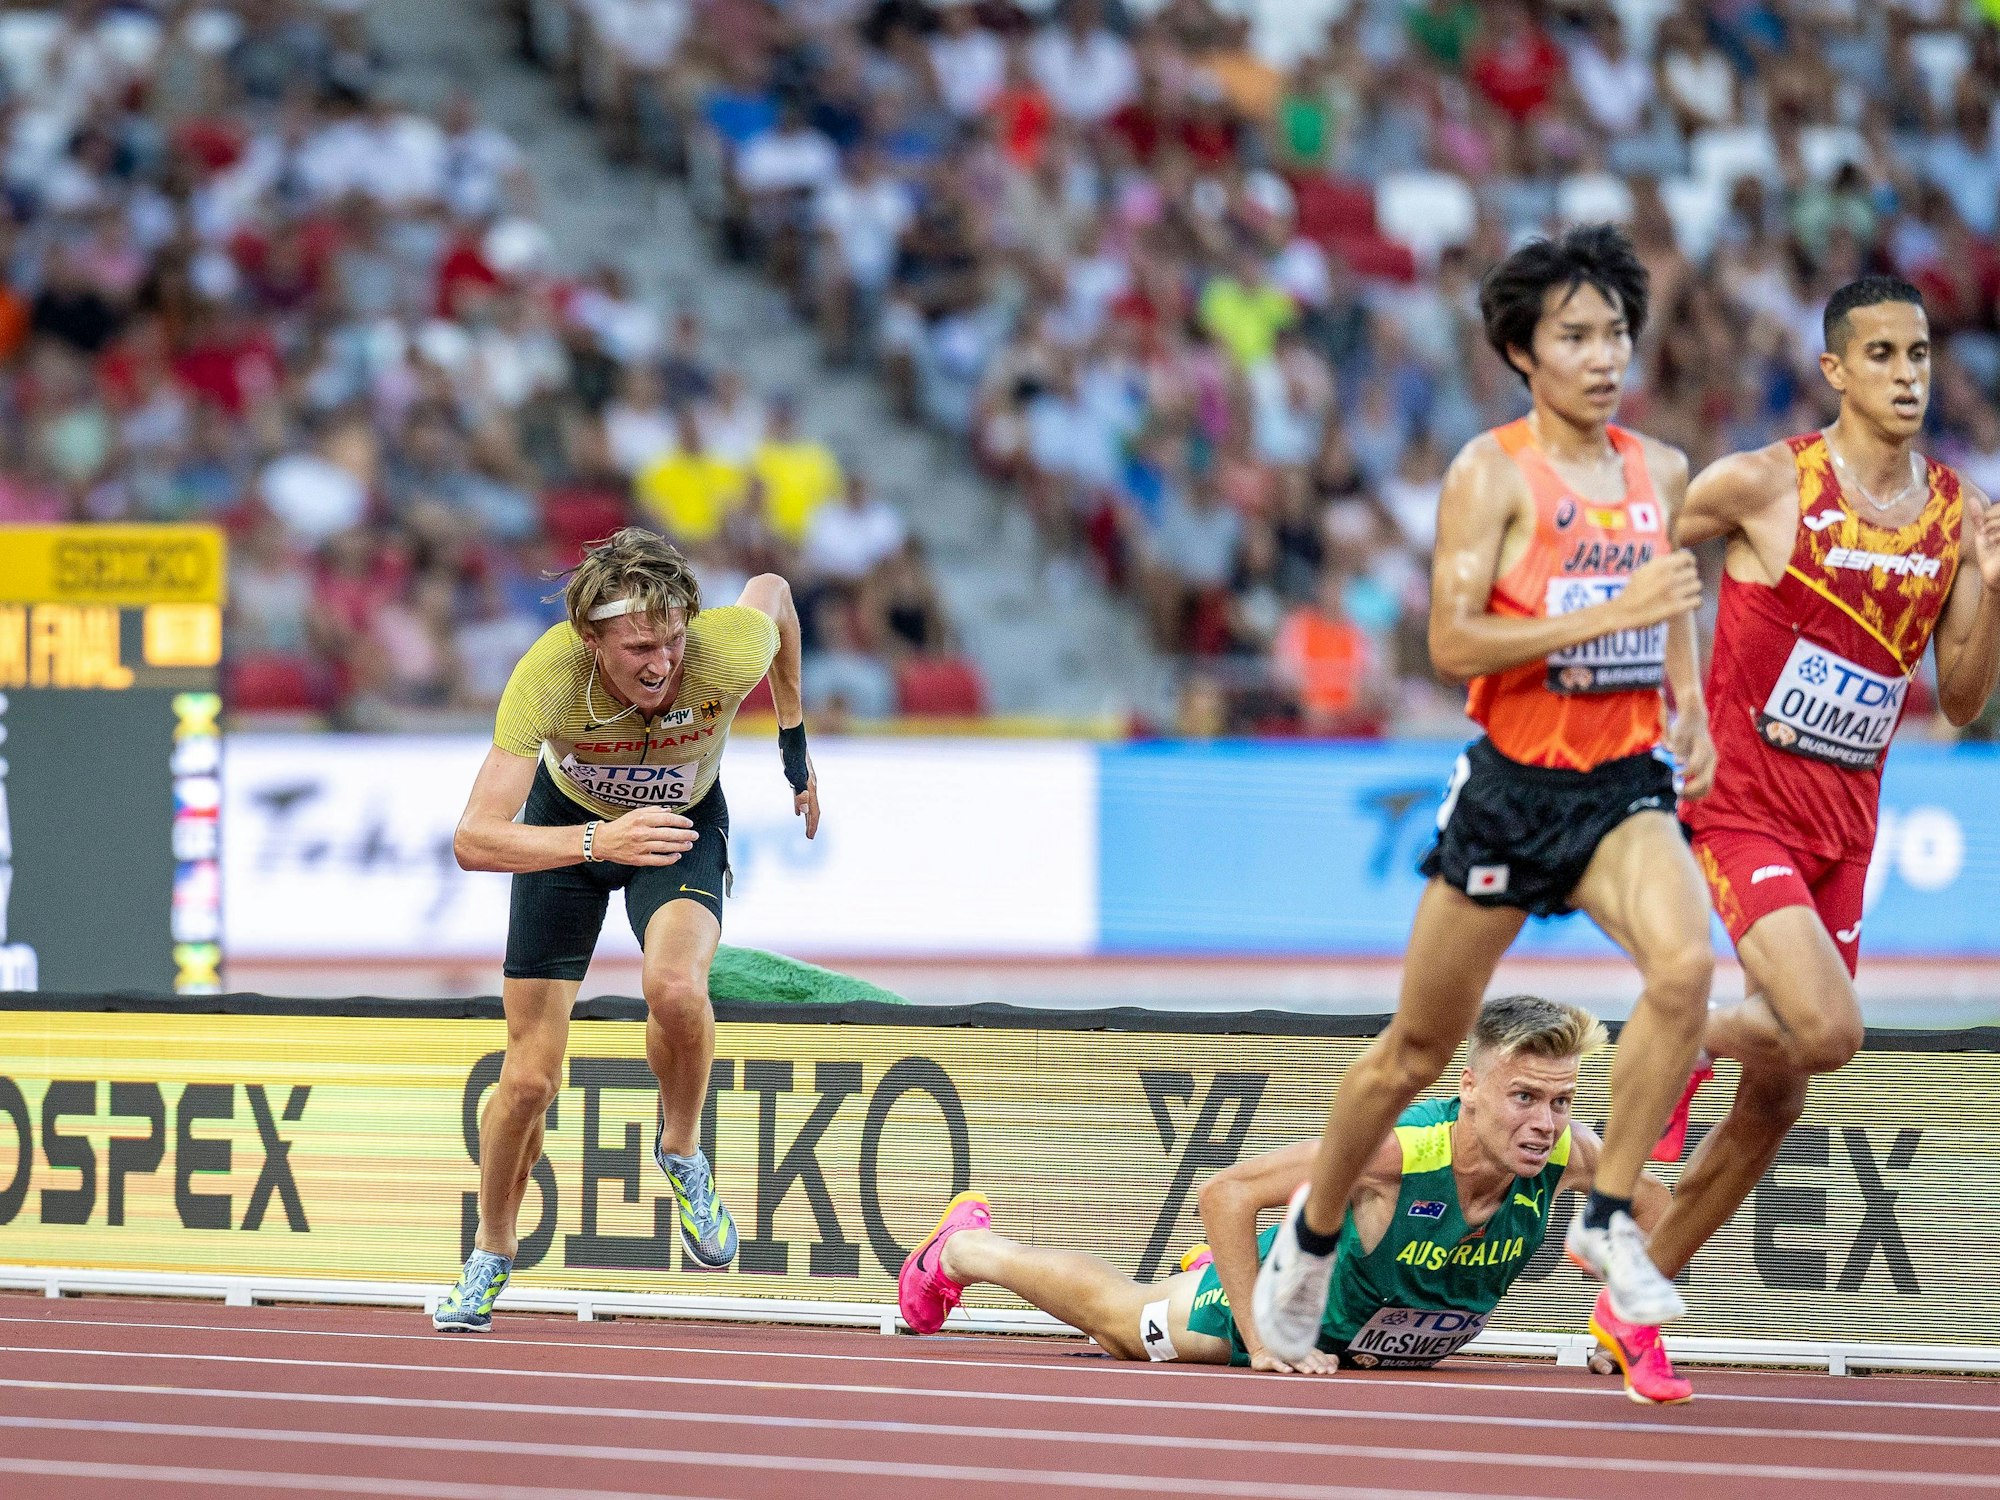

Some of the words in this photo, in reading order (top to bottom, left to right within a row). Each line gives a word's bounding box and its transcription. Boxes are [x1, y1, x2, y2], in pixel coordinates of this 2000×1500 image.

[53, 537, 208, 591] SEIKO
[1564, 542, 1653, 572] JAPAN
[1824, 547, 1942, 578] ESPAÑA
[1834, 664, 1904, 709] TDK
[1780, 687, 1892, 744] OUMAIZ
[574, 724, 716, 753] GERMANY
[598, 763, 685, 782] TDK
[460, 1050, 970, 1280] SEIKO
[1145, 1319, 1165, 1346] 4
[1412, 1311, 1482, 1332] TDK
